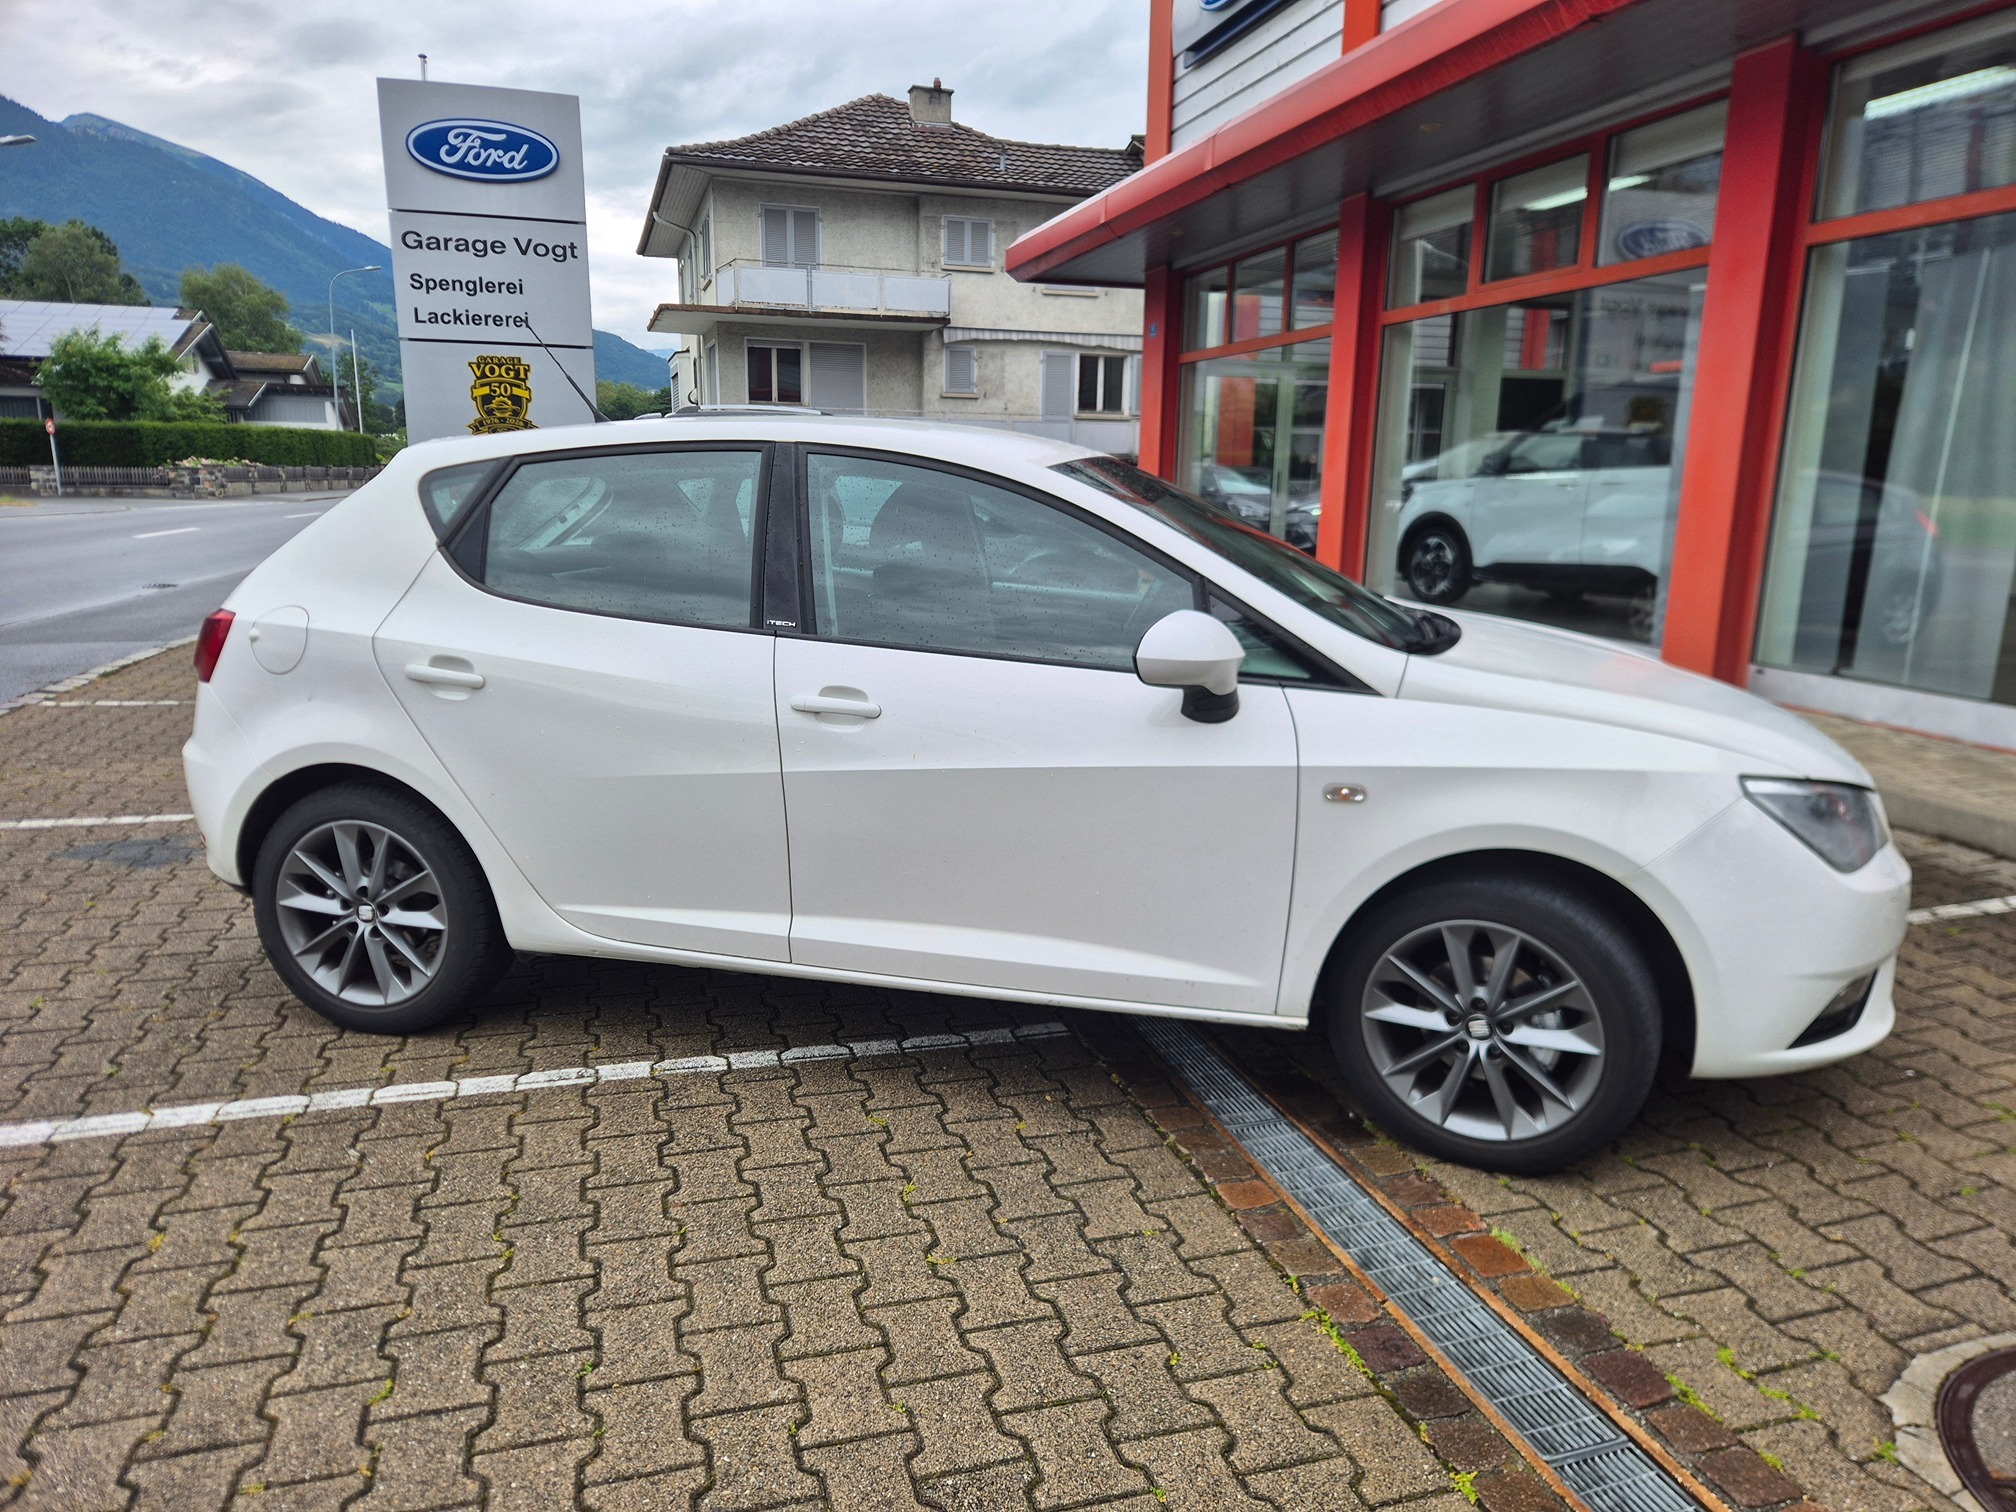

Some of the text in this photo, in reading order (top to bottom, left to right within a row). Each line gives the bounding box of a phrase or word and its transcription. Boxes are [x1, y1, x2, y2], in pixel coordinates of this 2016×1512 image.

[439, 127, 530, 170] Ford
[401, 231, 578, 263] Garage Vogt
[409, 273, 524, 297] Spenglerei
[413, 307, 530, 329] Lackiererei
[470, 364, 529, 378] VOGT
[478, 356, 519, 364] GARAGE
[490, 383, 511, 396] 50
